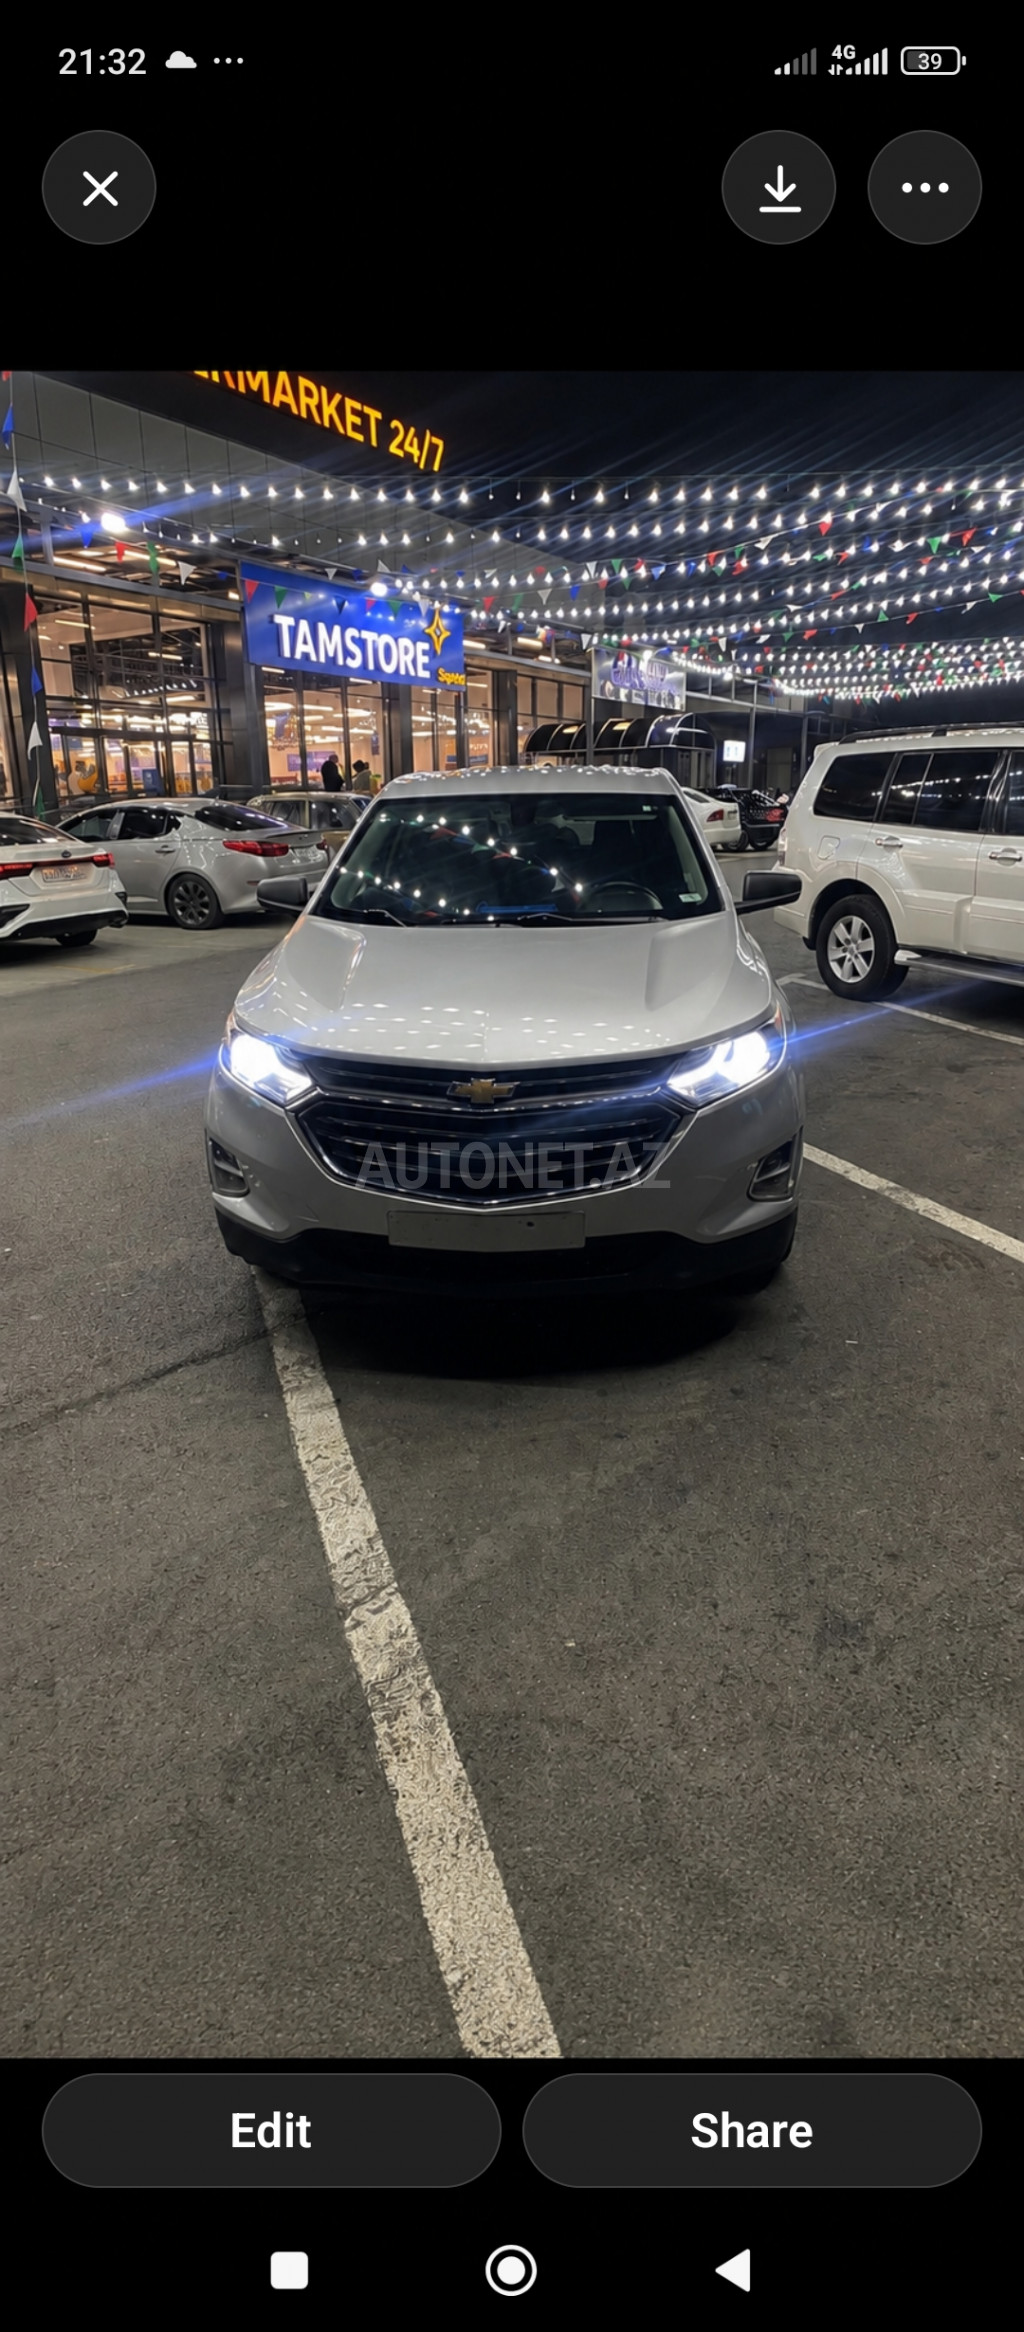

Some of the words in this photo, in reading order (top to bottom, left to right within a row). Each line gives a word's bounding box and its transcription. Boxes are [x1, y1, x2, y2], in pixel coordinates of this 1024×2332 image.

[193, 371, 383, 447] MARKET
[388, 419, 445, 472] 24/7
[273, 614, 431, 679] TAMSTORE
